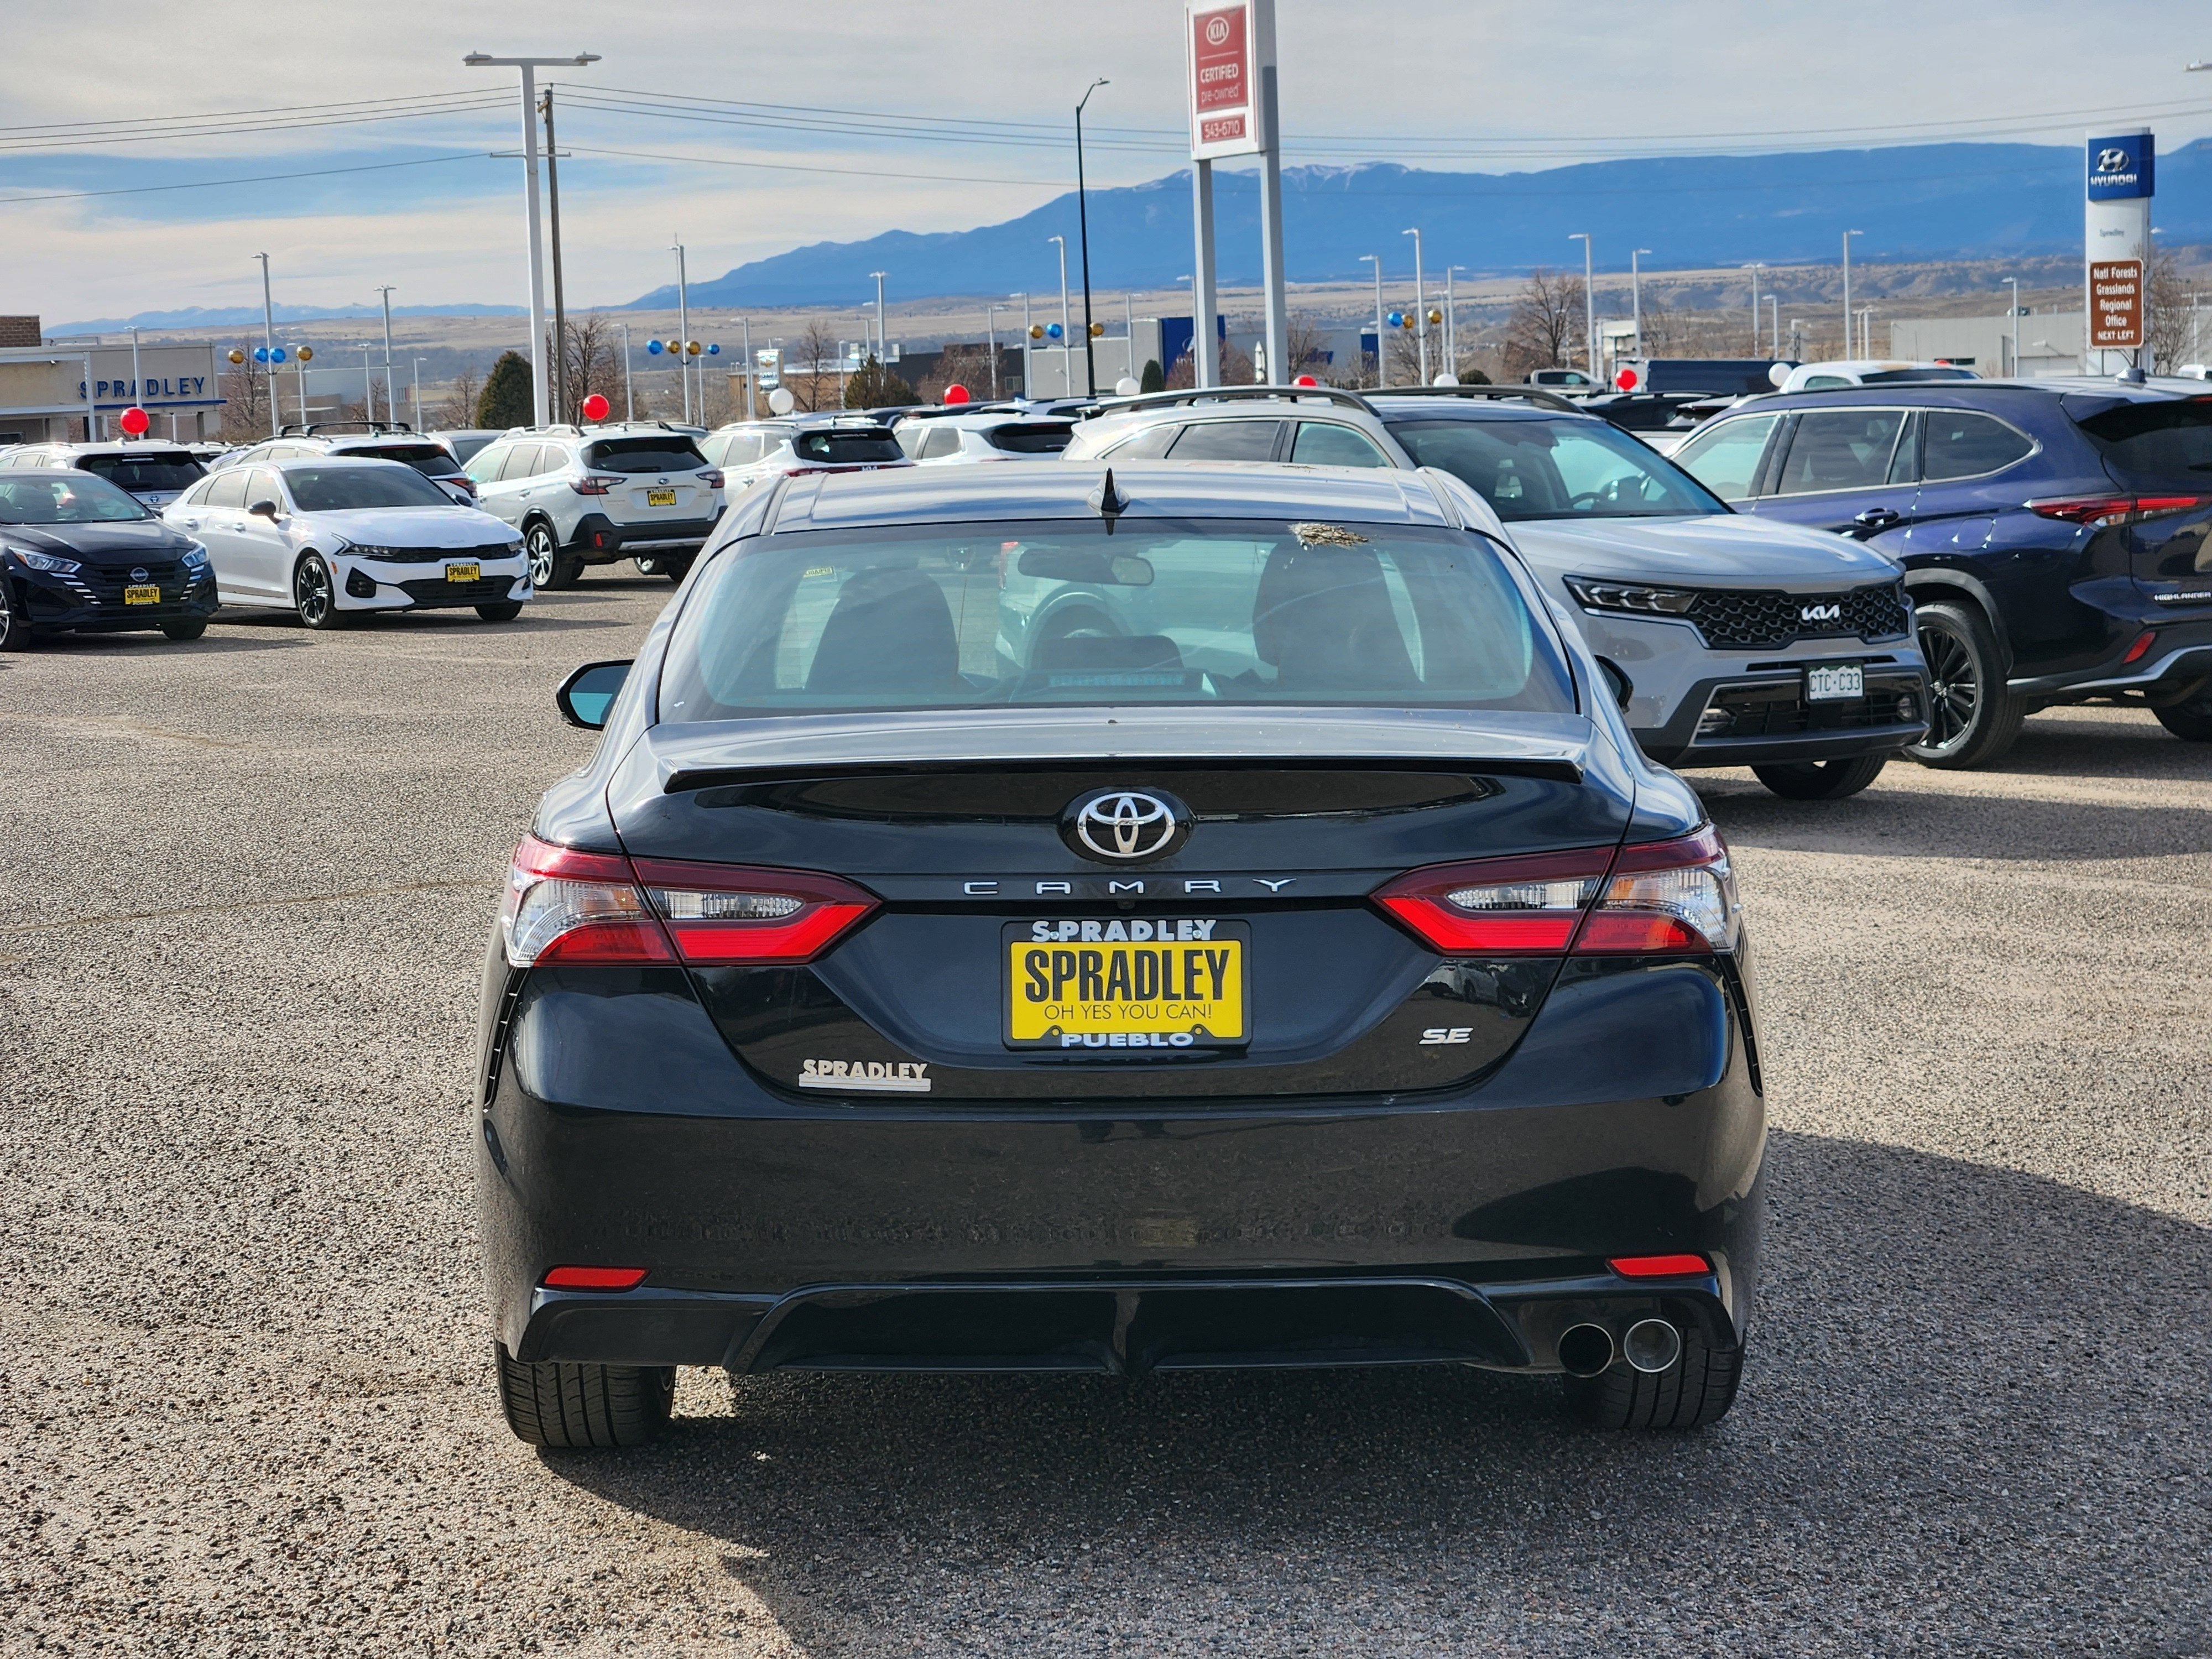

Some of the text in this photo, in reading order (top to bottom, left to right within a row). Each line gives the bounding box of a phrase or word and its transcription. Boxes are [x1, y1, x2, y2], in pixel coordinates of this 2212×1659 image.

[1210, 23, 1225, 39] KIA
[1200, 63, 1238, 84] CERTIFIED
[1204, 120, 1240, 138] 543-6710
[2090, 173, 2137, 186] HYUNDAI
[2111, 266, 2137, 279] Forests
[2096, 283, 2135, 295] Grasslands
[2100, 298, 2132, 314] Regional
[2105, 314, 2127, 327] Office
[2098, 330, 2134, 341] NEXT LEFT
[449, 566, 477, 576] SPRADLEY
[127, 588, 158, 598] SPRADLEY
[964, 878, 1297, 895] CAMRY
[1031, 920, 1217, 942] SPRADLEY
[1025, 949, 1230, 1002] SPRADLEY
[1044, 1004, 1212, 1019] OH YES YOU CAN!
[1061, 1032, 1194, 1047] PUEBLO
[1419, 1027, 1474, 1045] SE
[803, 1058, 928, 1082] SPRADLEY
